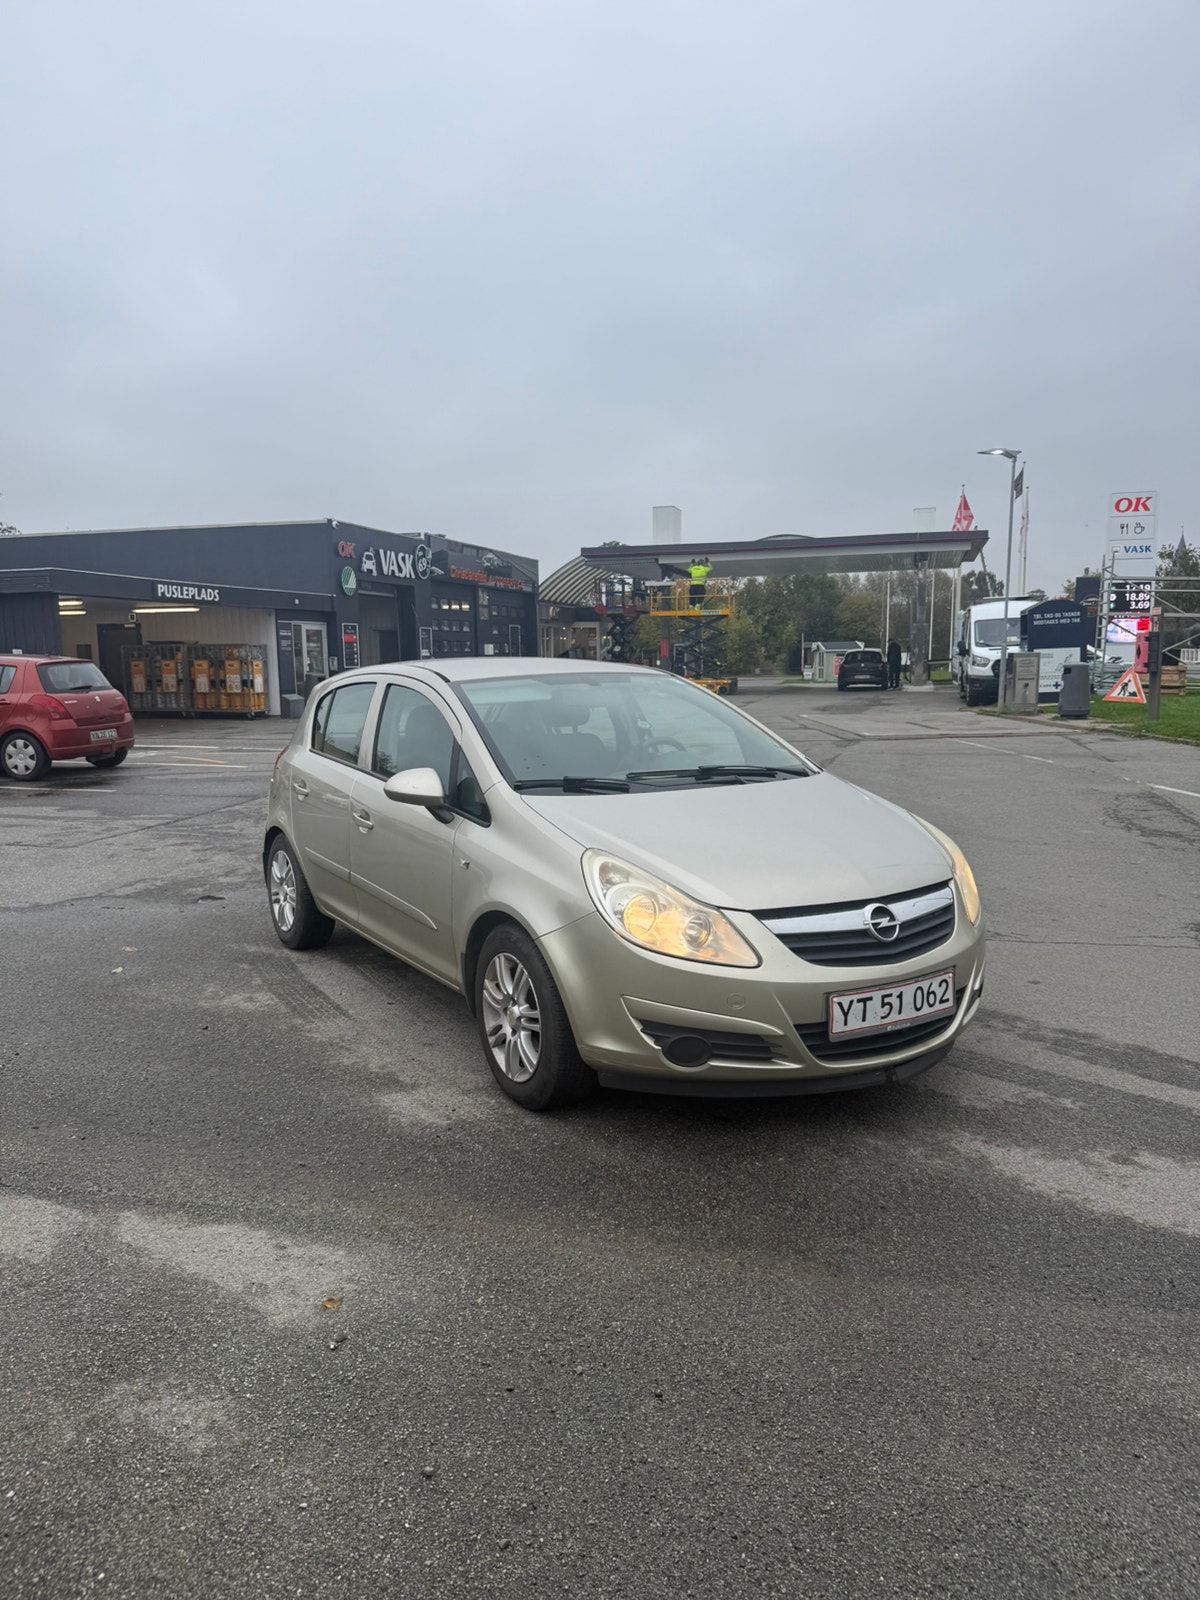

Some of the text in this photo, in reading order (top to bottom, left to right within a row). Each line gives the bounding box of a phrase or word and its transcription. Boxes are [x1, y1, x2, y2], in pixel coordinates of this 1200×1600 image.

[1113, 496, 1153, 513] OK
[338, 541, 356, 558] OK
[1124, 545, 1152, 554] VASK
[379, 548, 415, 579] VASK
[157, 584, 219, 602] PUSLEPLADS
[1125, 593, 1150, 601] 18.89
[1129, 601, 1150, 609] 3.69
[837, 978, 950, 1027] YT 51 062
